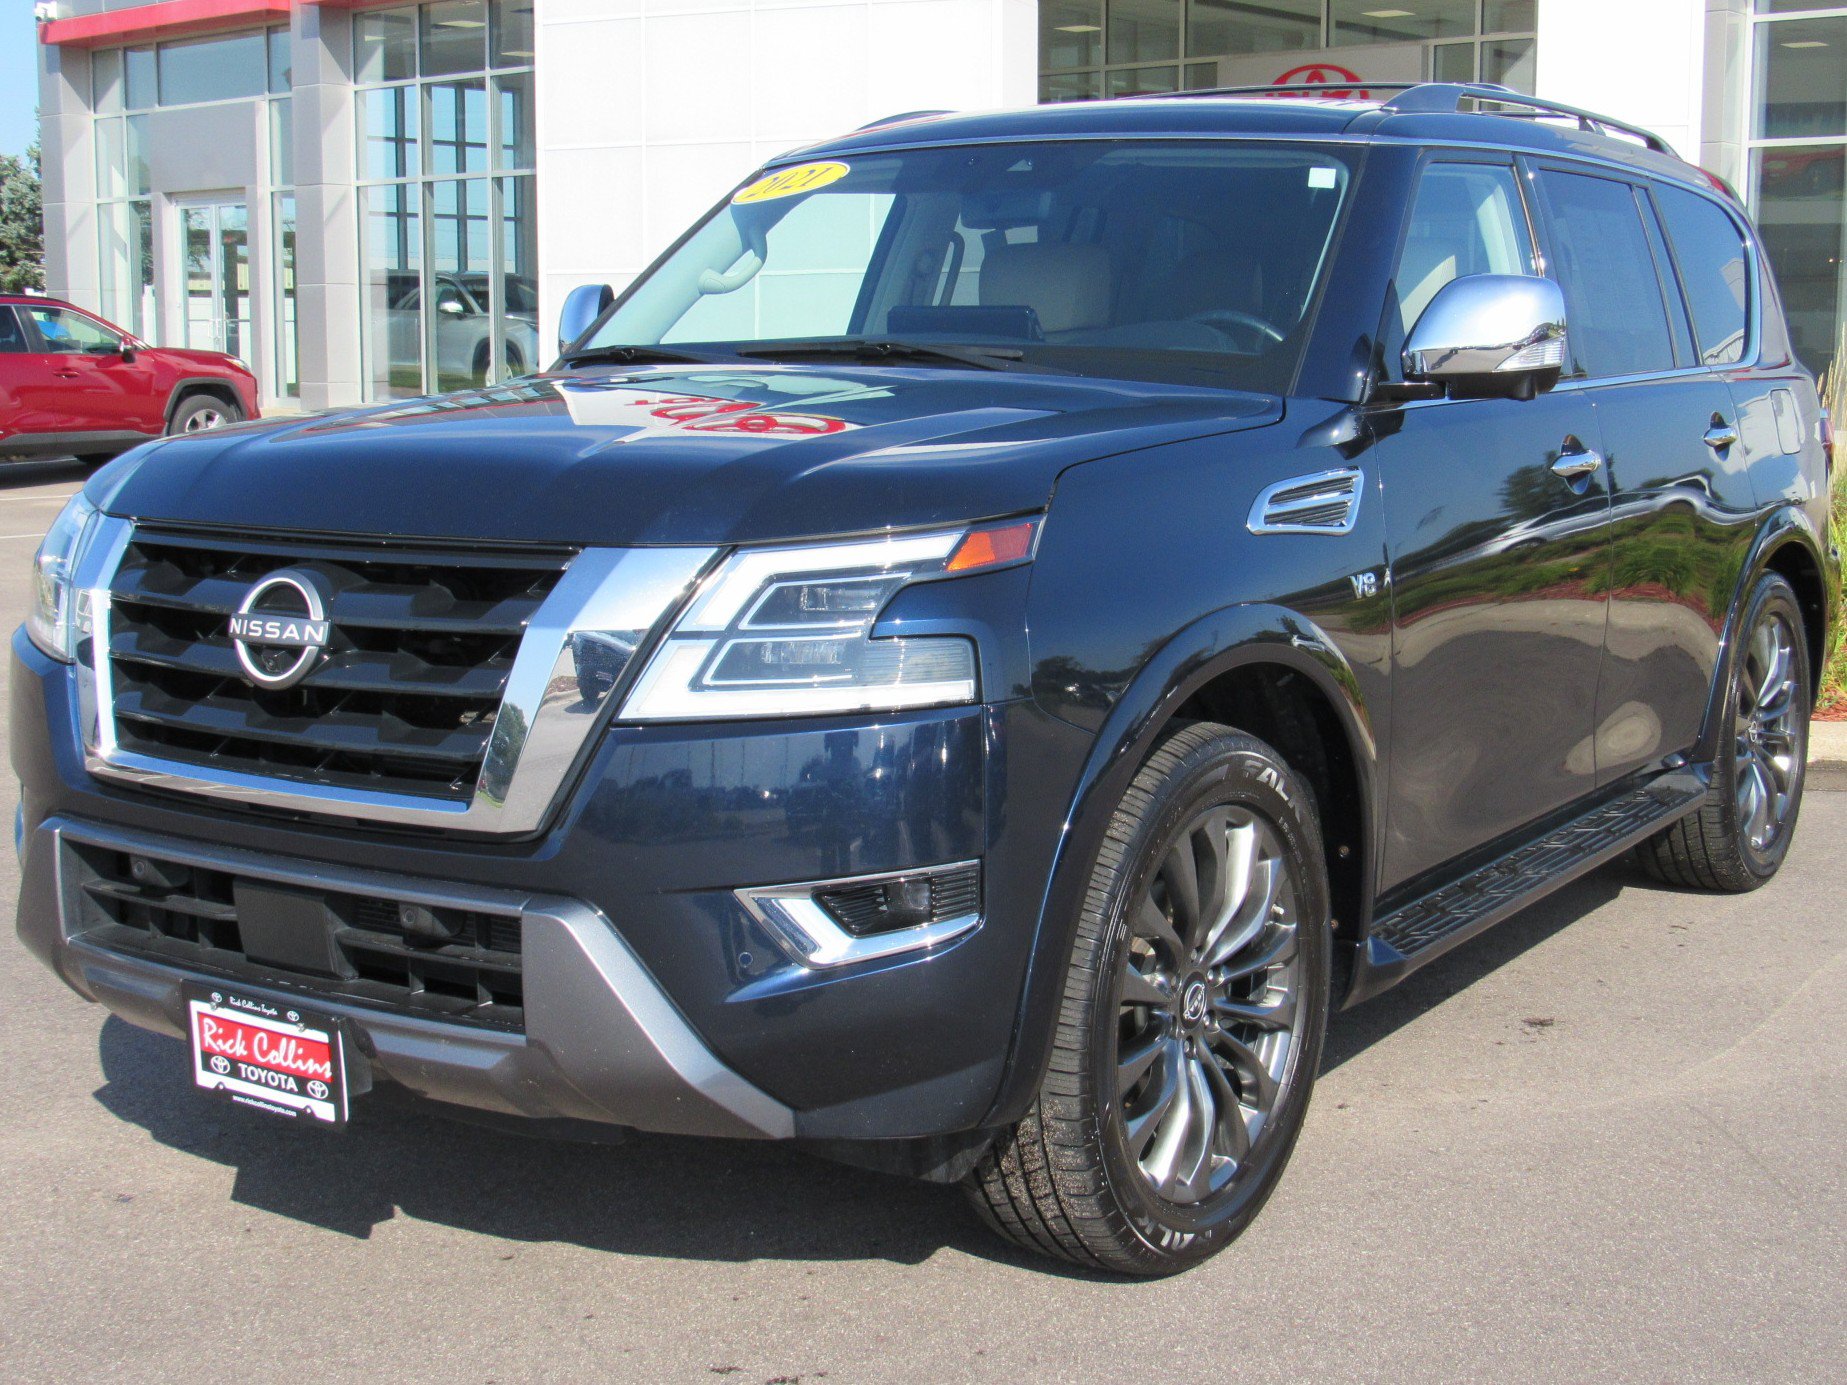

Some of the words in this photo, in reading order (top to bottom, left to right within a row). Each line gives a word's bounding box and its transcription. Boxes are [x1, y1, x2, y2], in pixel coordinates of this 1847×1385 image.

[743, 166, 835, 199] 2021
[1349, 572, 1377, 599] V8
[229, 617, 325, 643] NISSAN
[203, 1017, 248, 1057] Rick
[253, 1031, 332, 1079] Collins
[238, 1063, 299, 1093] TOYOTA
